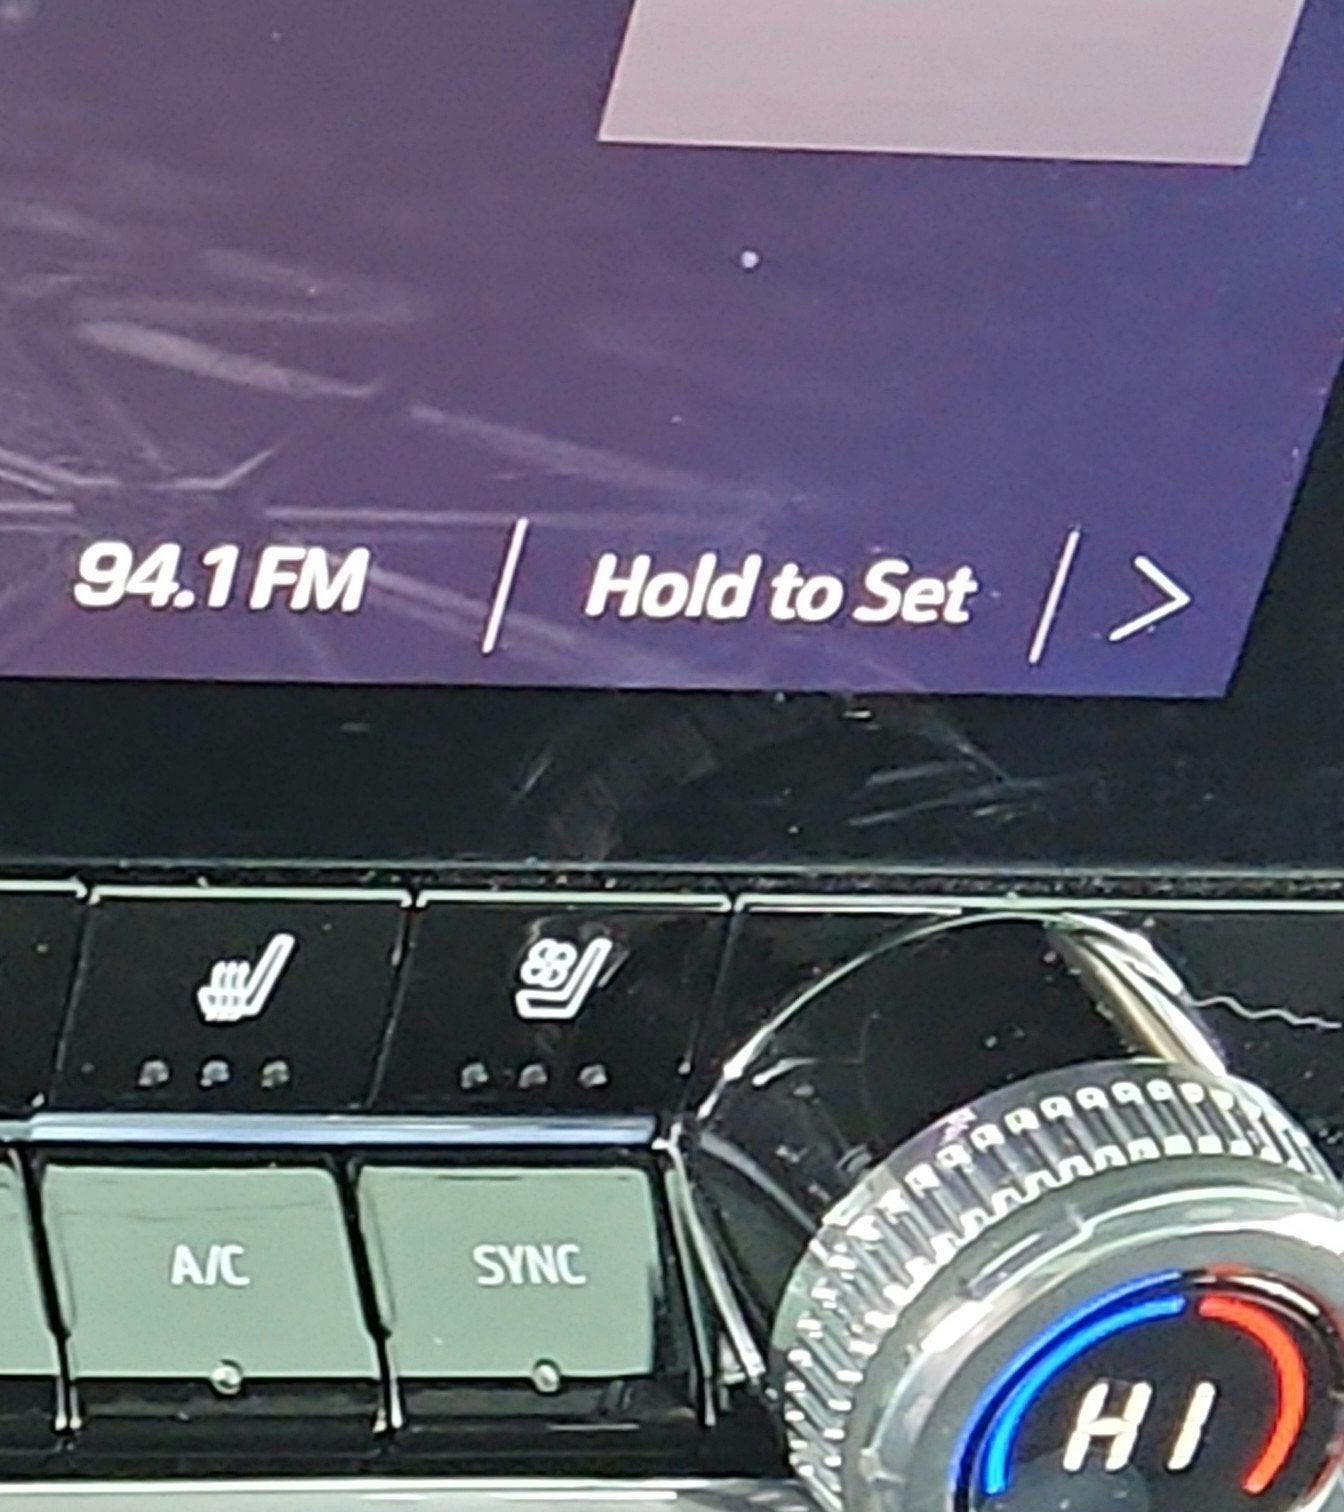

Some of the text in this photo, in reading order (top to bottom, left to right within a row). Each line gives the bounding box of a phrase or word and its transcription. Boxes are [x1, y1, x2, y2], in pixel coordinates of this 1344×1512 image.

[72, 540, 370, 615] 94.1 FM
[582, 552, 978, 627] Hold to Set
[170, 1243, 252, 1288] A/C
[472, 1242, 589, 1288] SYNC
